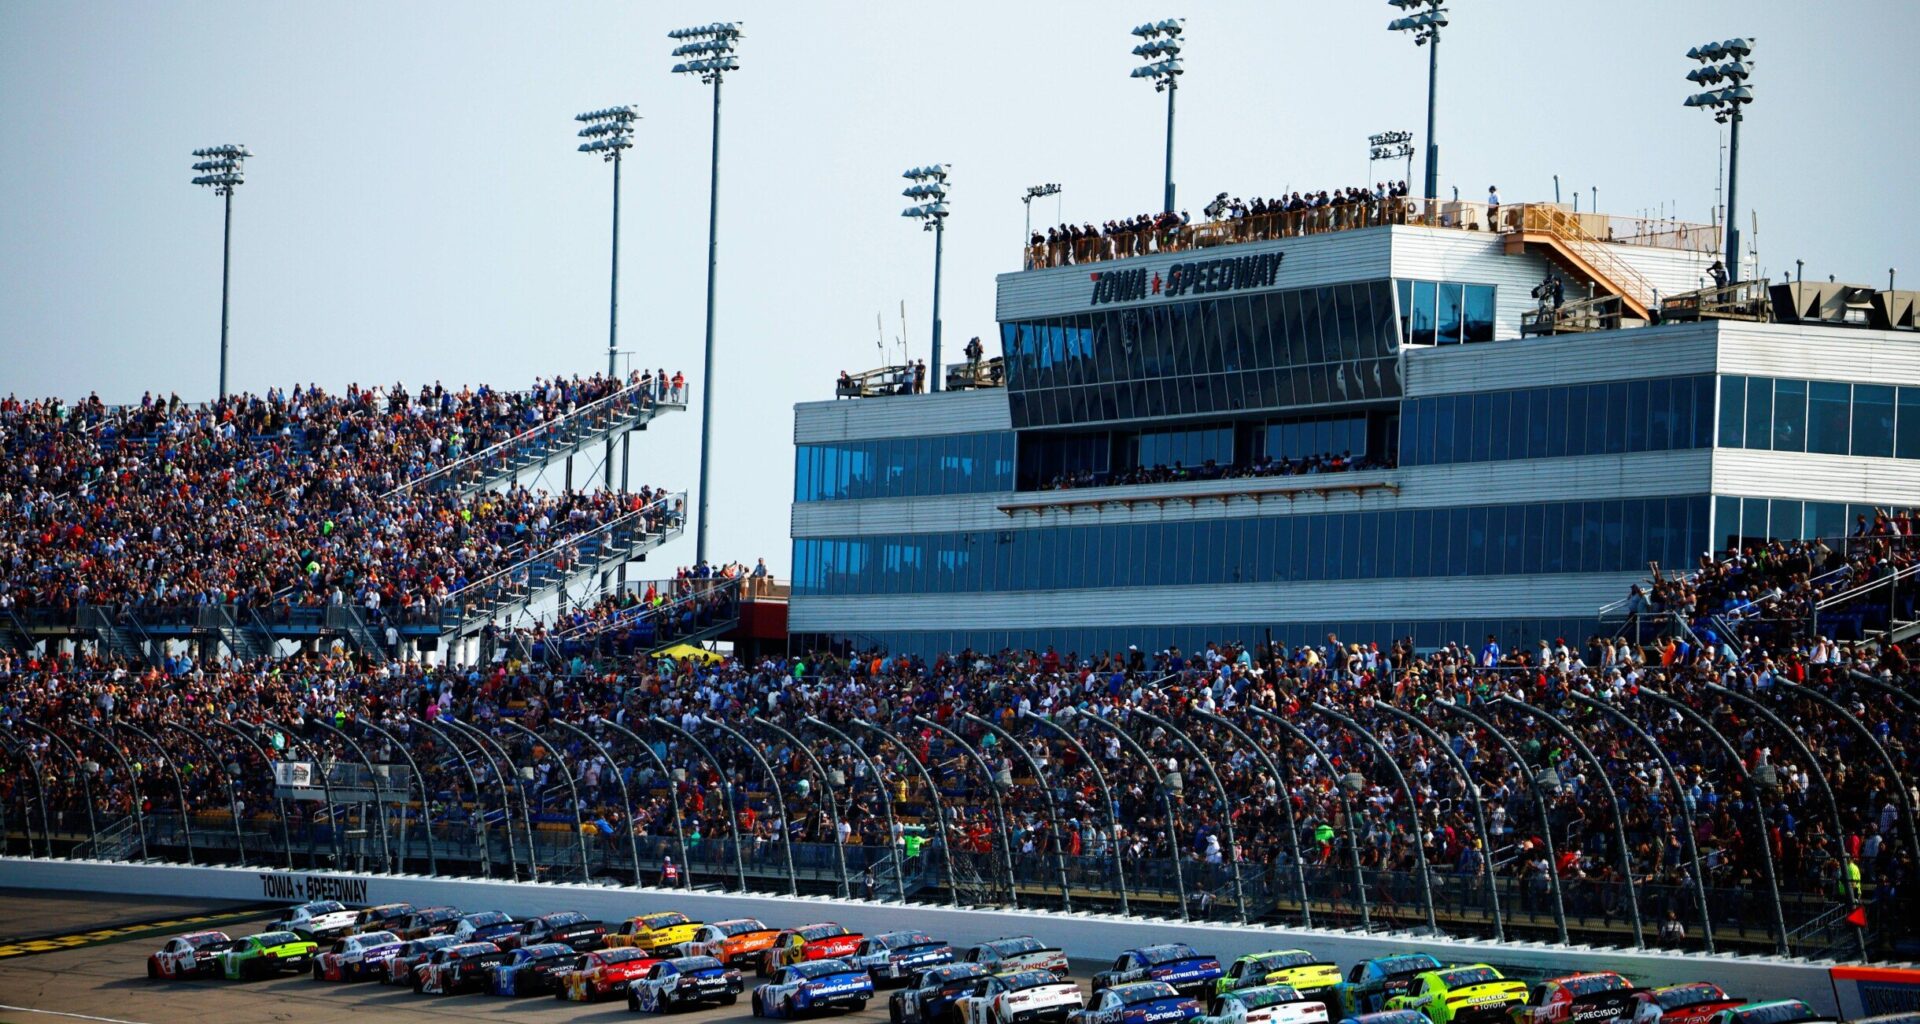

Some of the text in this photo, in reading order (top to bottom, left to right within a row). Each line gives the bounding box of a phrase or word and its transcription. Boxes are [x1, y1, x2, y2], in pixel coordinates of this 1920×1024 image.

[1090, 252, 1284, 305] IOWA SPEEDWAY
[260, 875, 367, 903] IOWA SPEEDWAY
[1161, 970, 1199, 982] SWEETWATER
[1480, 1002, 1506, 1011] TOYOTA
[1146, 1009, 1185, 1022] Benesch
